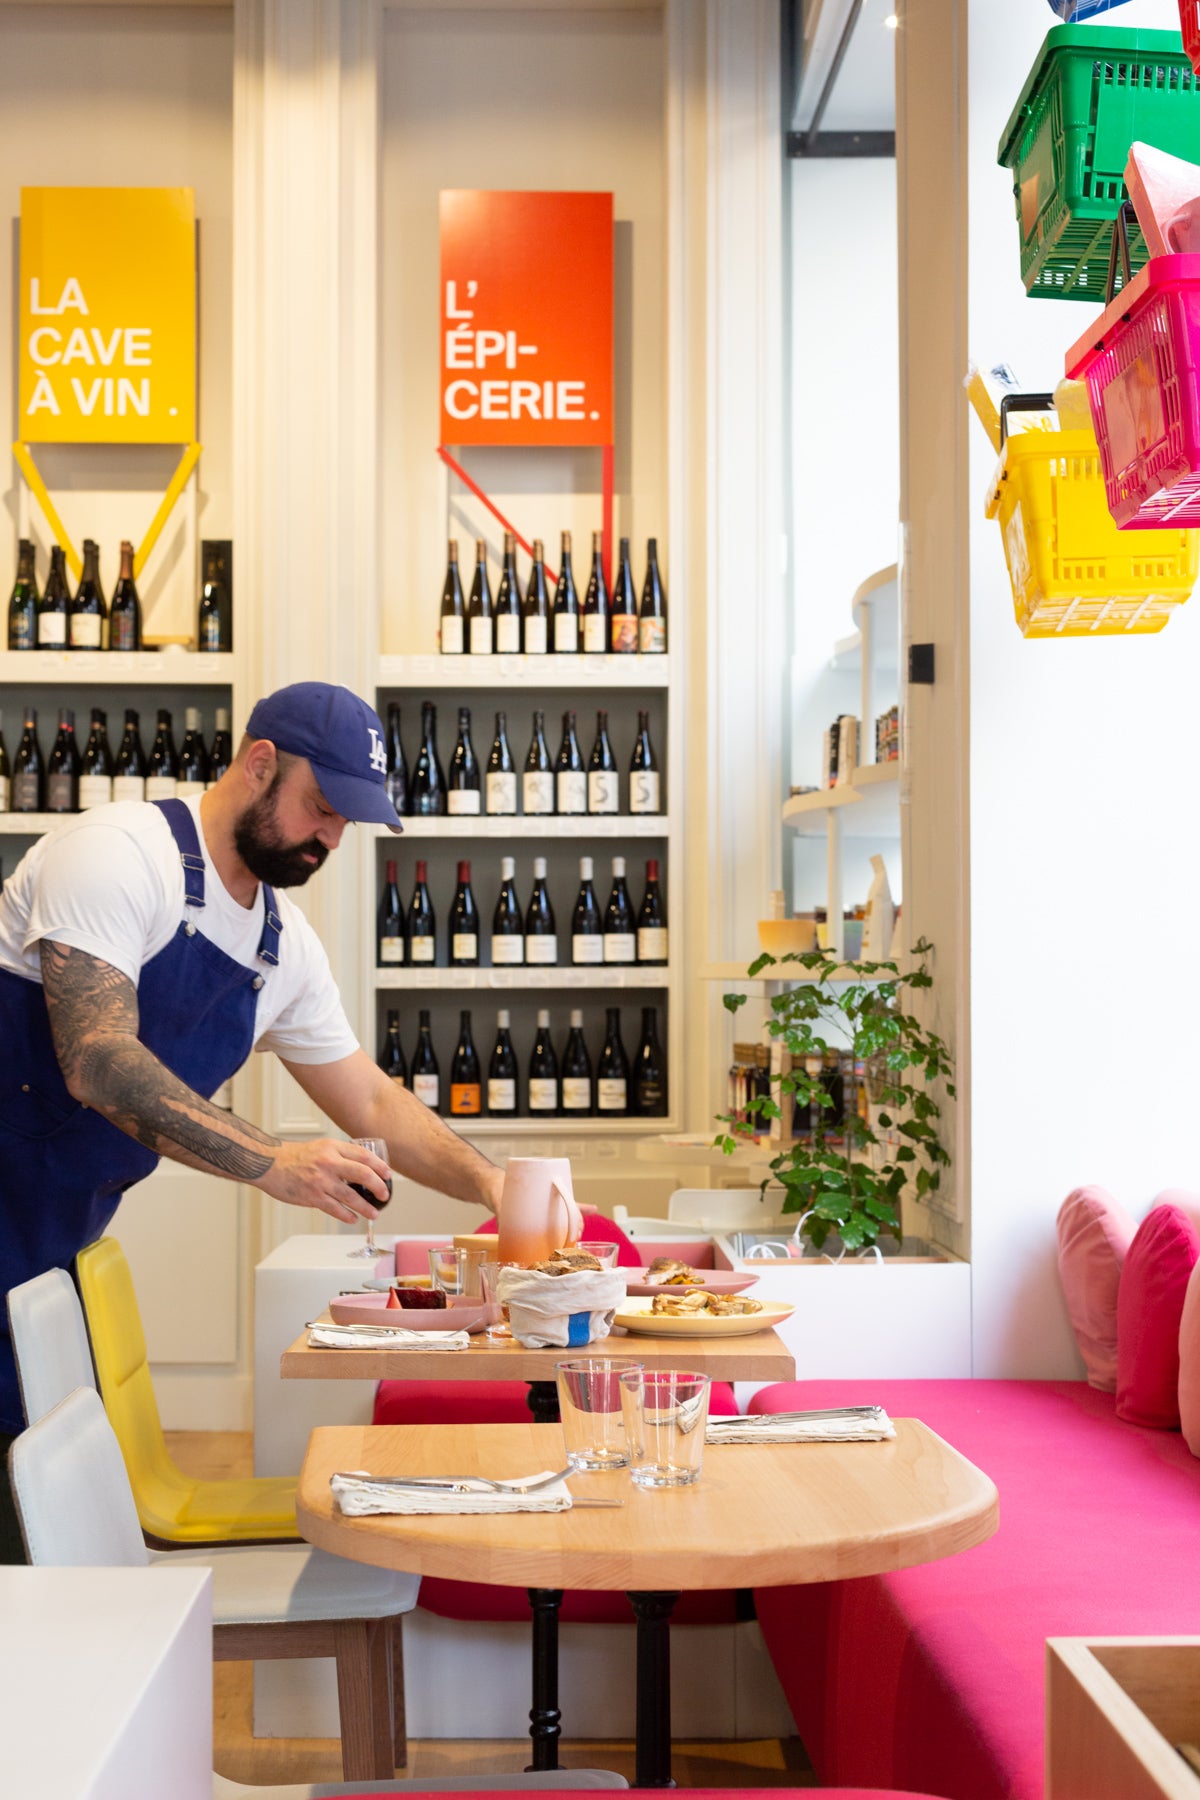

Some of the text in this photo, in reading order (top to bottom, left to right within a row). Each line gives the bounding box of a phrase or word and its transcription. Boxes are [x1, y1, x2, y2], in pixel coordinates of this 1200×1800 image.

[29, 277, 90, 316] LA
[28, 327, 152, 367] CAVE
[445, 322, 539, 370] ÉPI-
[26, 370, 61, 416] À
[71, 377, 151, 416] VIN
[444, 379, 601, 421] CERIE.
[367, 727, 388, 775] LA
